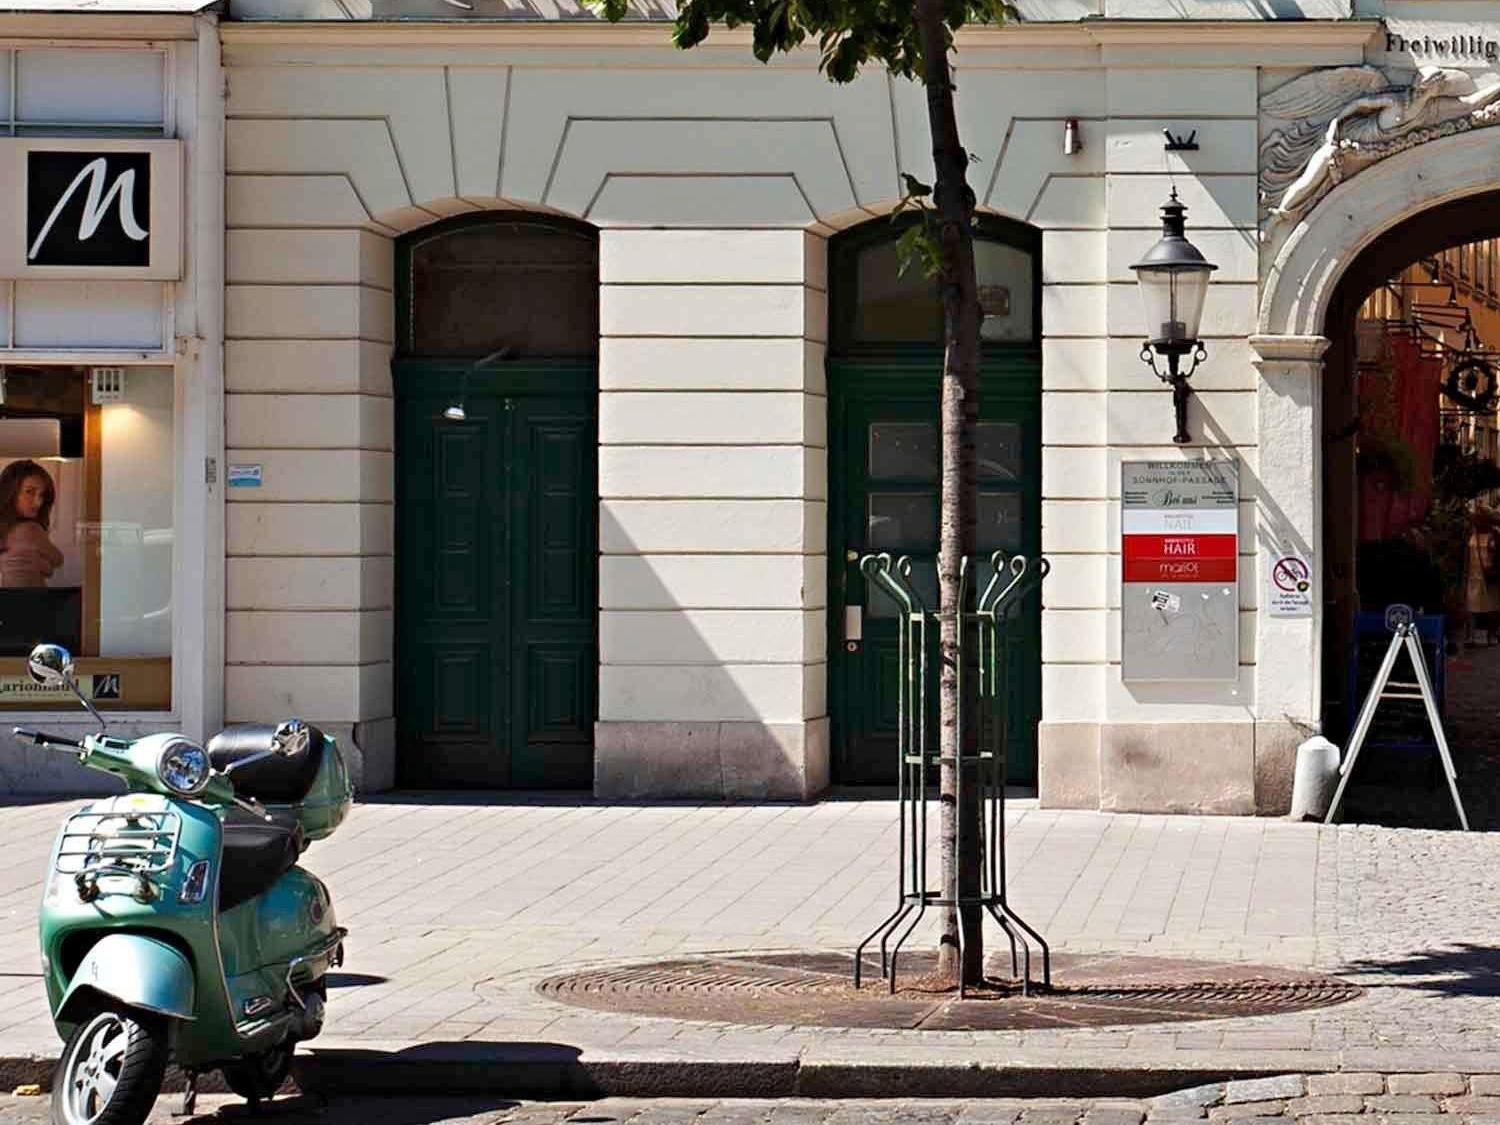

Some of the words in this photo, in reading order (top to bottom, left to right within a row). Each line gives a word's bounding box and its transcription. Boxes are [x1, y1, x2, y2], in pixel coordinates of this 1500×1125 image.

[1385, 32, 1498, 59] Freiwillig
[28, 157, 150, 260] M
[1164, 543, 1196, 555] HAIR
